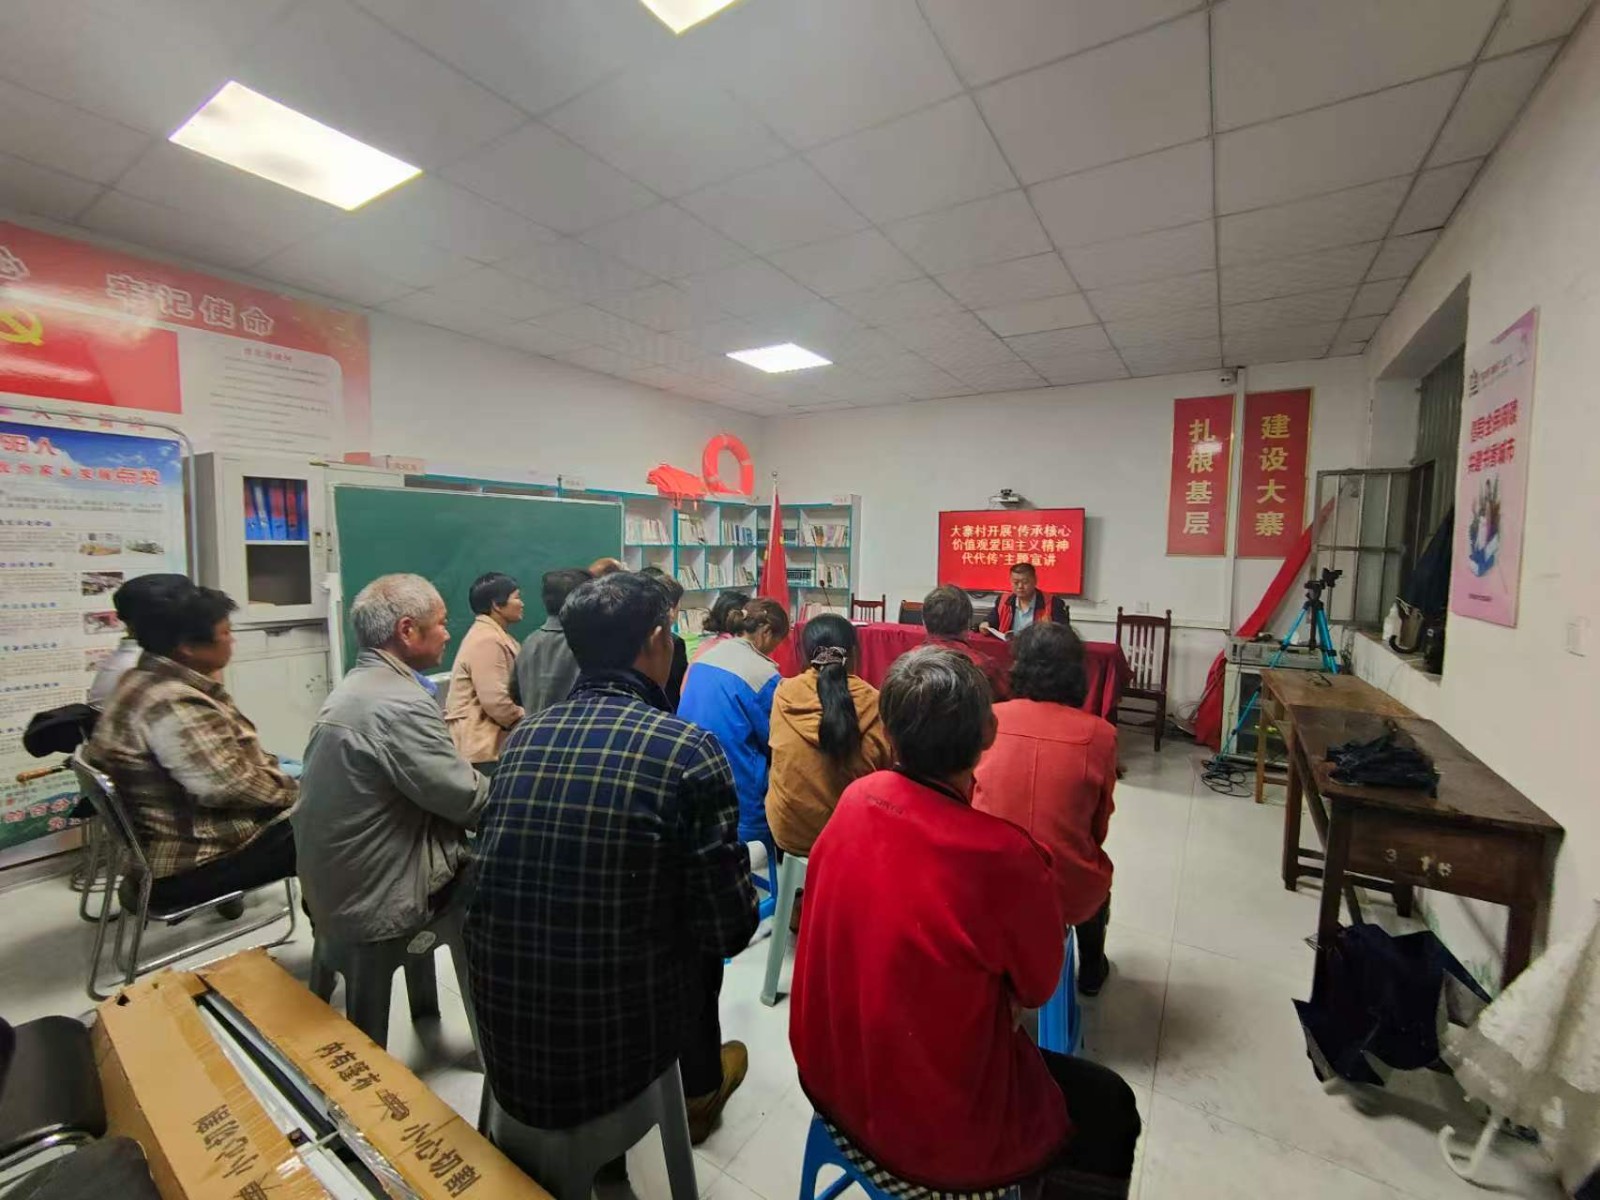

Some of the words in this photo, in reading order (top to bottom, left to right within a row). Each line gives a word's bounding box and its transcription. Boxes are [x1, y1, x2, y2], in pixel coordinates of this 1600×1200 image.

[1182, 418, 1217, 535] 扎根基层
[1255, 413, 1291, 536] 建设大寨
[951, 538, 1070, 552] 价值观爱国主义精神
[400, 1122, 482, 1199] 小心切割
